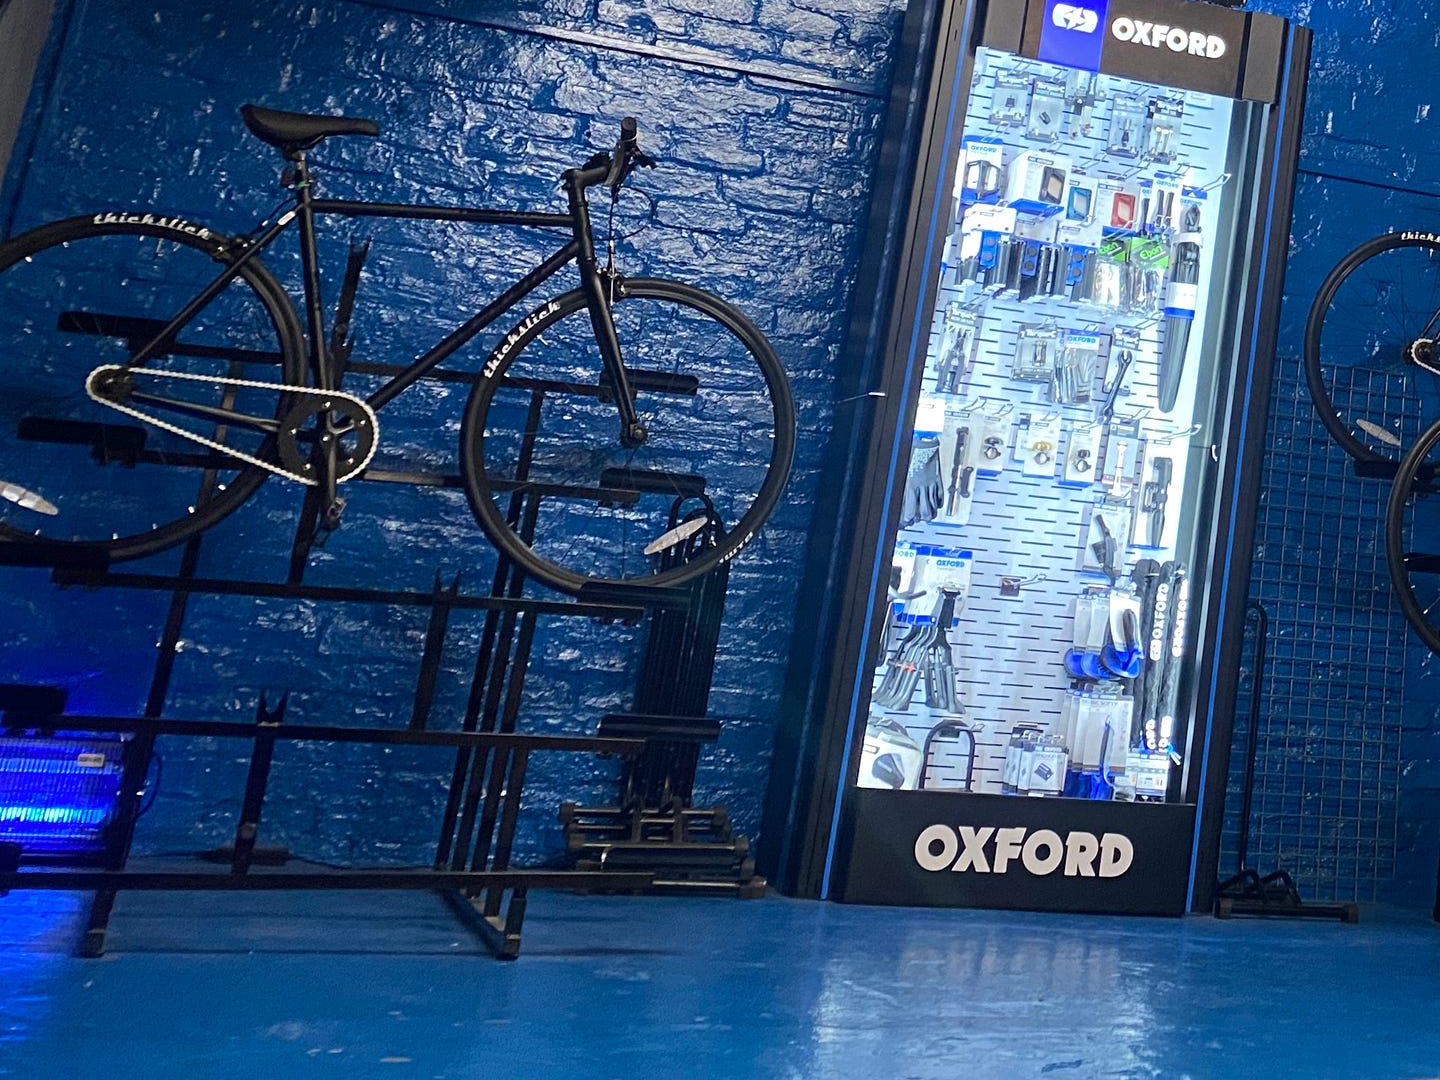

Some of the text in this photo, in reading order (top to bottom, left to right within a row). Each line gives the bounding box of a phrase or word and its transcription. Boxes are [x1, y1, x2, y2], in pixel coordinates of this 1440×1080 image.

[1111, 16, 1226, 59] OXFORD
[970, 144, 997, 153] OXFORD
[93, 211, 211, 241] thickslick
[483, 301, 561, 379] thickslick
[1066, 335, 1096, 344] OXFORD
[936, 559, 965, 568] OXFORD
[1151, 583, 1169, 640] OXFORD
[914, 823, 1134, 878] OXFORD
